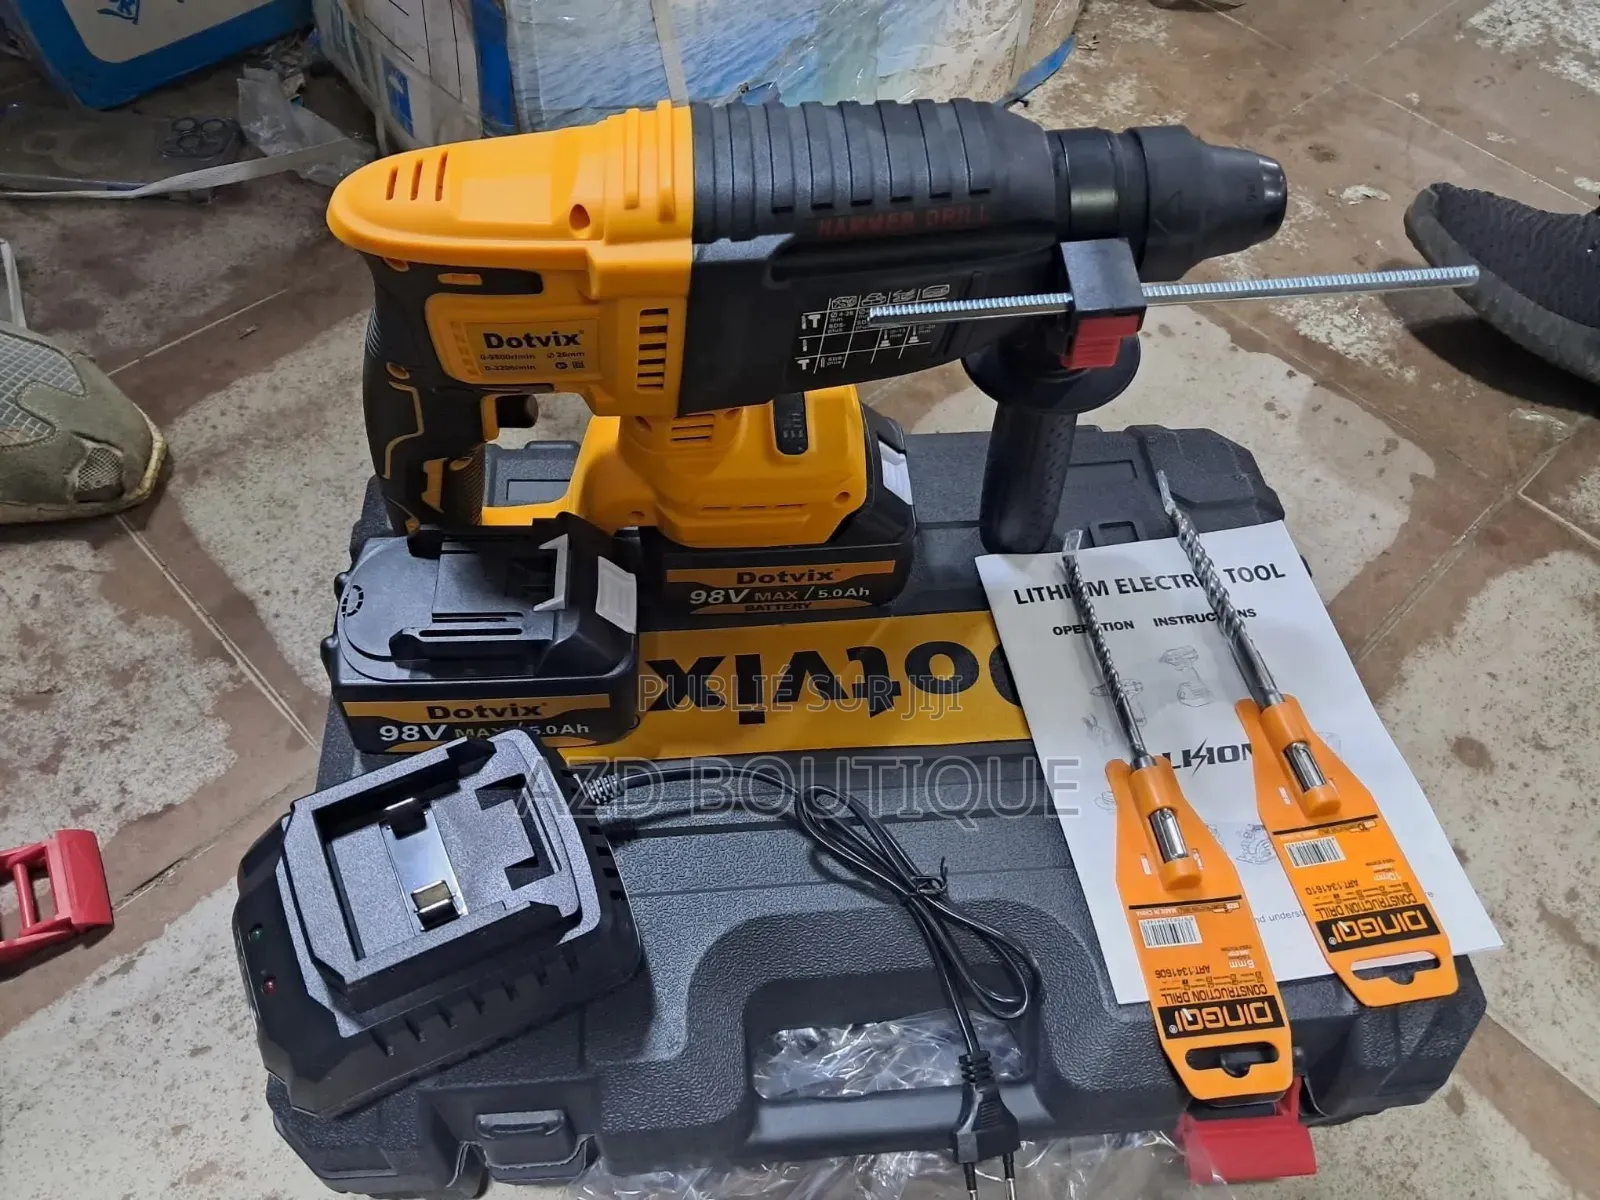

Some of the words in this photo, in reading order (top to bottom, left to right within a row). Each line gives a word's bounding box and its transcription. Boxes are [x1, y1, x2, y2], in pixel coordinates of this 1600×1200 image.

[819, 211, 915, 237] HAMMER
[483, 331, 581, 349] Dotvix
[736, 570, 834, 585] Dotvix
[1013, 580, 1109, 605] LITHIM
[1115, 574, 1199, 595] ELECTR
[1223, 563, 1286, 585] TOOL
[690, 589, 751, 604] 98V
[755, 590, 798, 601] MAX
[745, 602, 812, 612] BATTERY
[427, 703, 541, 720] Dotvix
[379, 724, 447, 742] 98V
[1315, 905, 1344, 919] DRILL
[1345, 893, 1418, 915] CONSTRUCTION
[1332, 909, 1428, 944] DINGQI
[1161, 992, 1191, 1005] DRILL
[1191, 984, 1268, 1002] CONSTRUCTION
[1174, 1001, 1274, 1033] DINGQI
